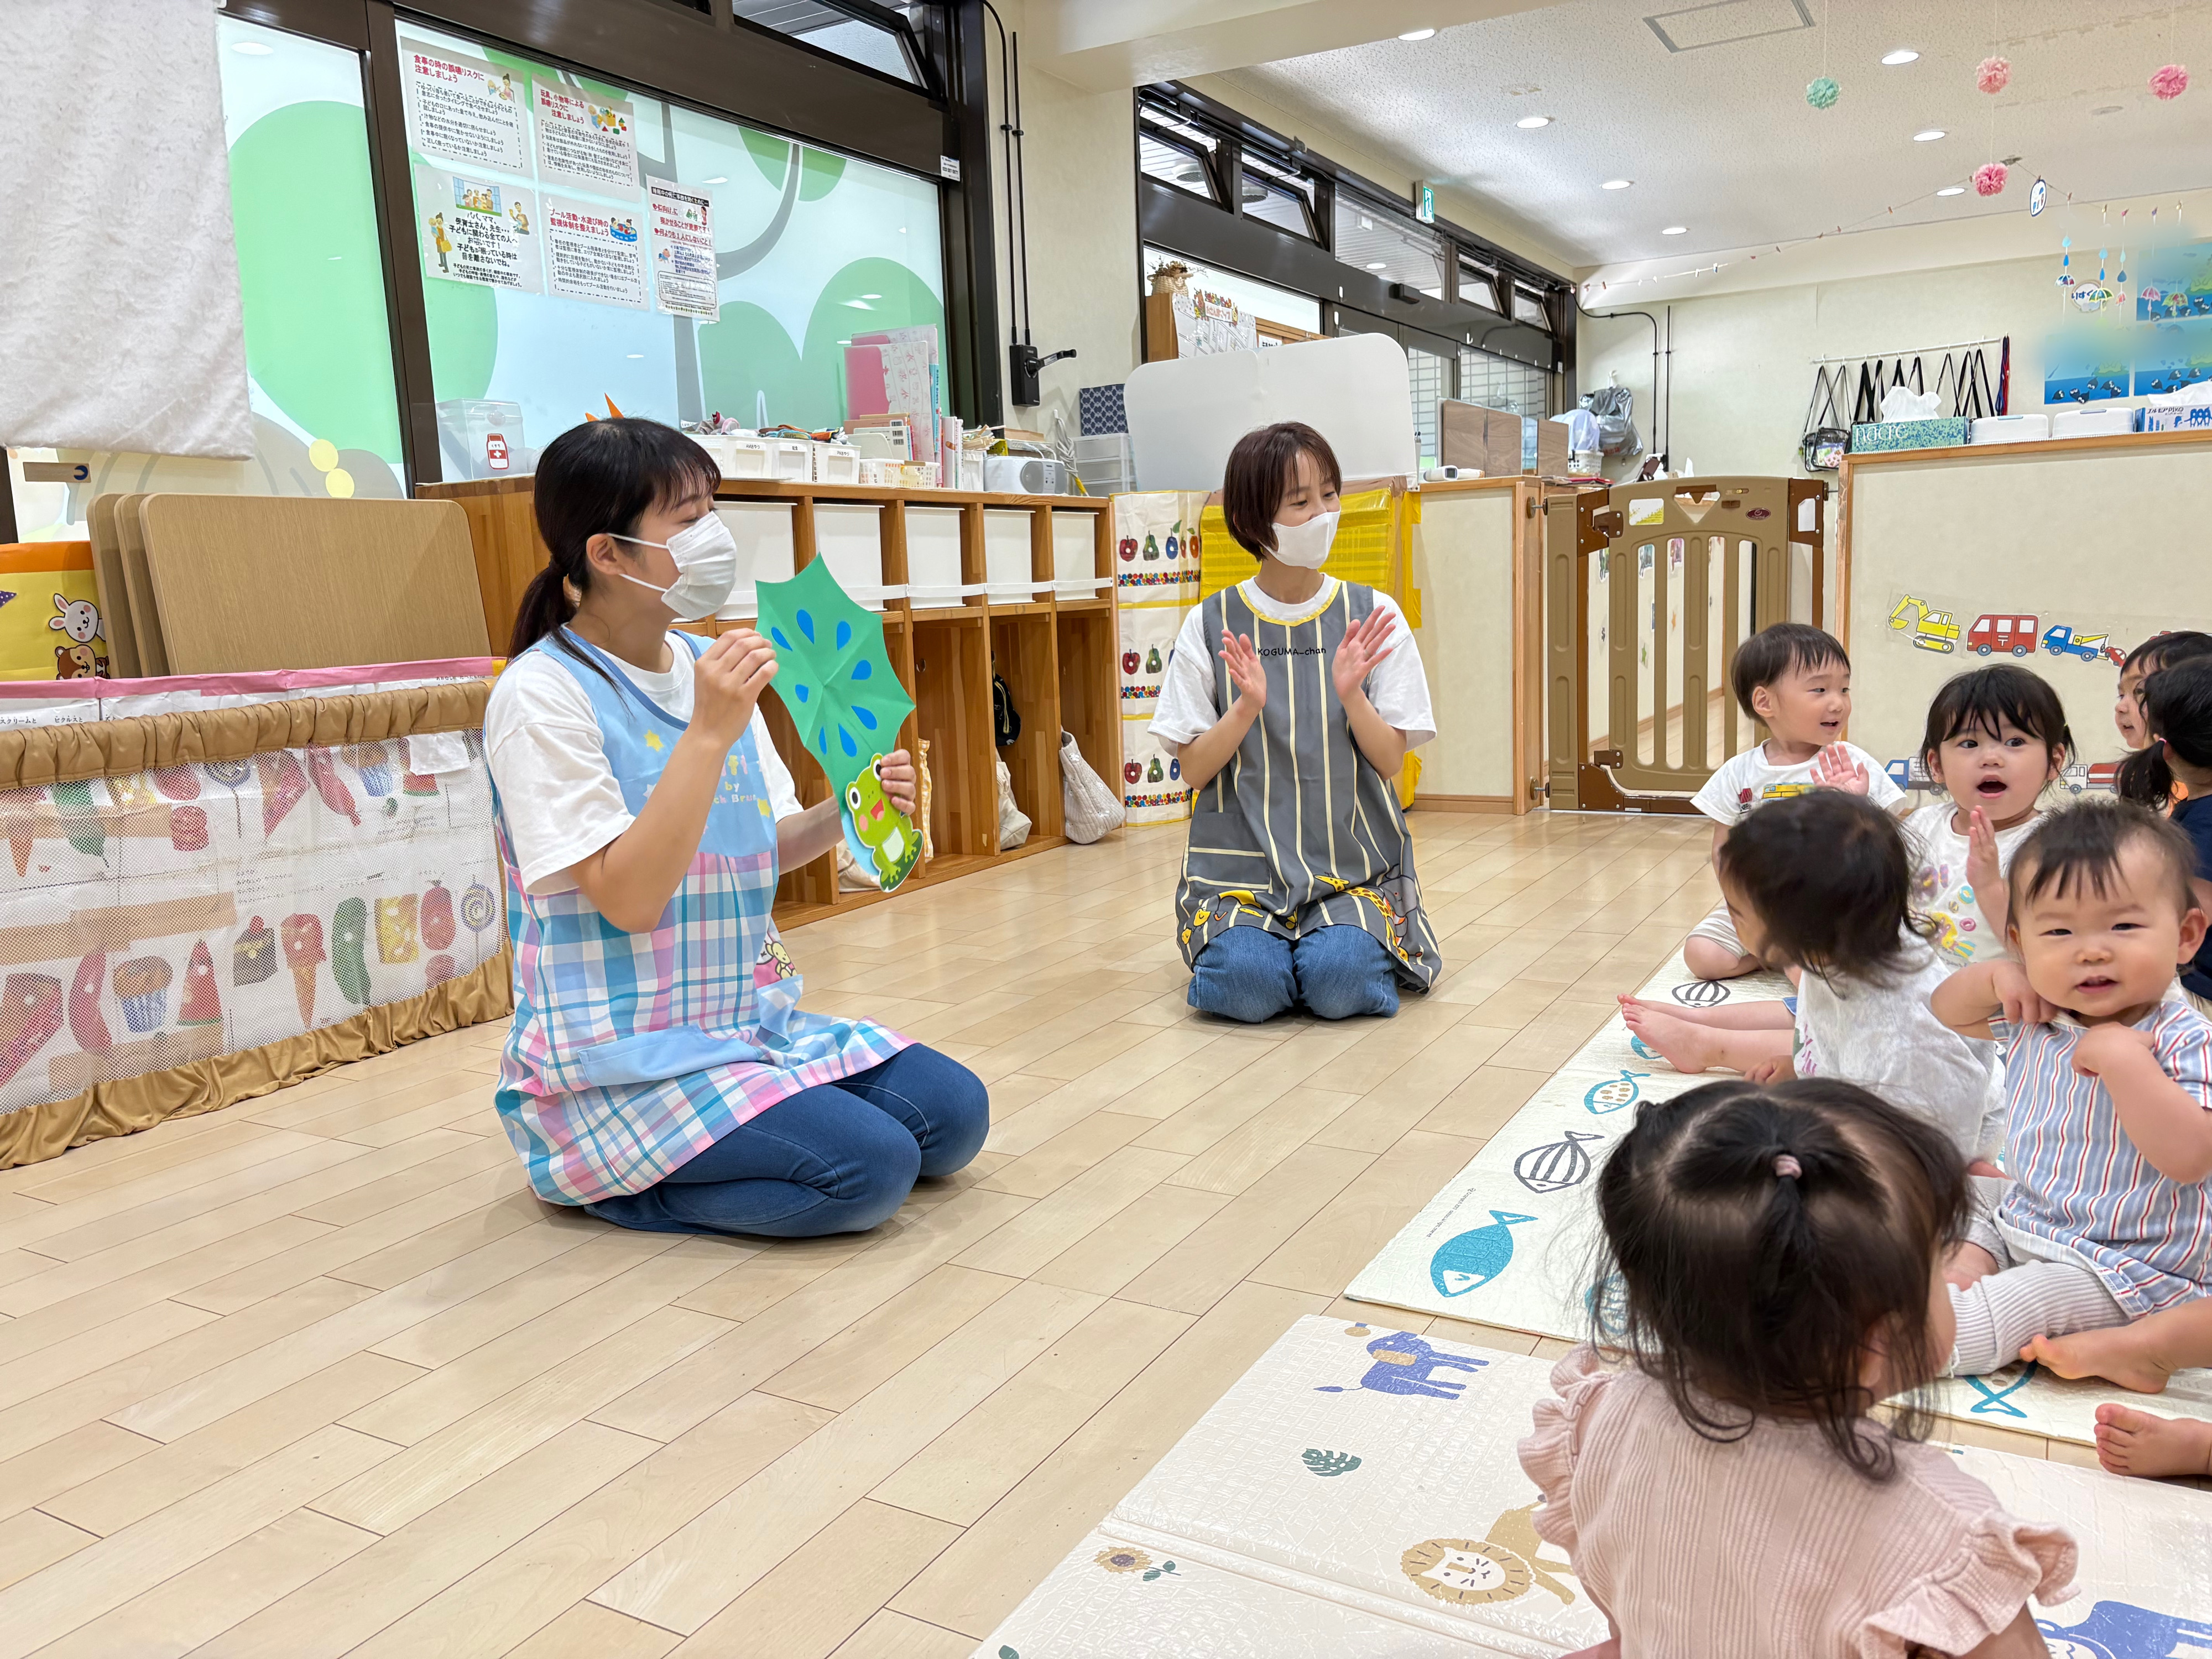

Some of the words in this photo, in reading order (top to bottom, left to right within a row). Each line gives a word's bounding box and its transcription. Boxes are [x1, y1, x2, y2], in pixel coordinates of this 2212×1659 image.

[414, 55, 485, 81] 食事の時の誤嚥リスクに
[415, 64, 458, 83] 注意しましょう
[551, 109, 584, 124] 注意しましょう
[550, 217, 609, 237] 監視体制を整えましょう
[1856, 424, 1908, 444] nacre
[724, 781, 739, 792] by
[713, 795, 727, 804] ck
